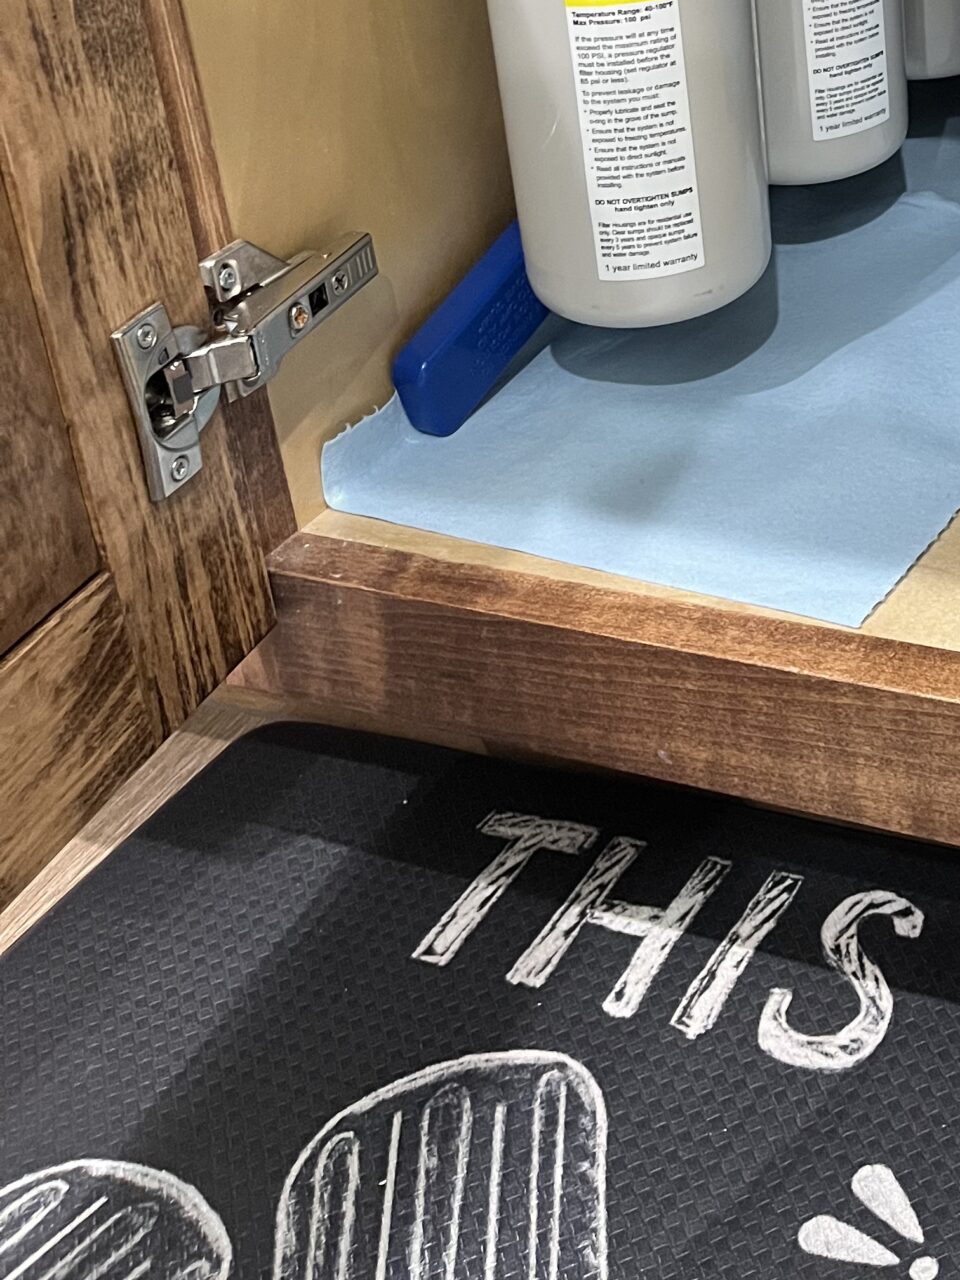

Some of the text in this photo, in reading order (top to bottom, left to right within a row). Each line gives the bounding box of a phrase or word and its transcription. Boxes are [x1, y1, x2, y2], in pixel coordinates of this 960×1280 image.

[825, 123, 840, 132] year
[842, 117, 863, 128] limited
[864, 107, 886, 120] warranty
[612, 264, 630, 272] year
[633, 261, 661, 270] limited
[663, 253, 697, 266] warranty
[412, 810, 925, 1071] THIS
